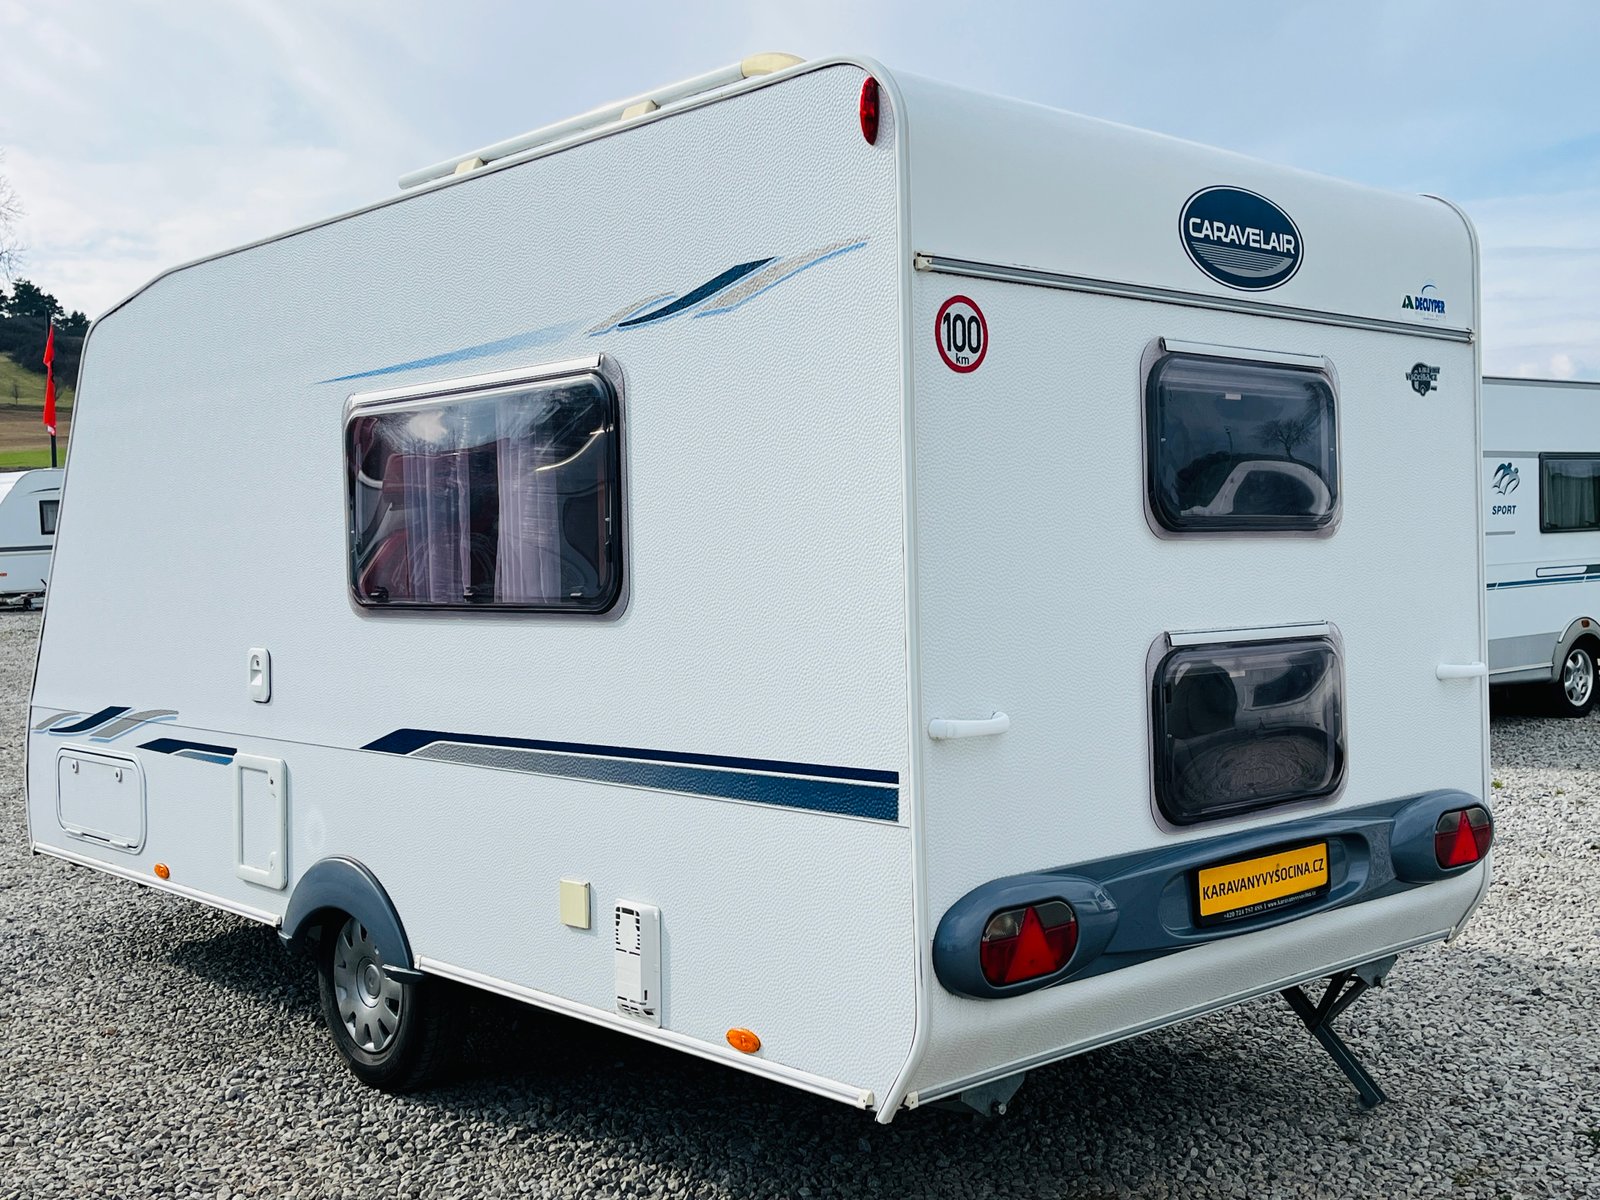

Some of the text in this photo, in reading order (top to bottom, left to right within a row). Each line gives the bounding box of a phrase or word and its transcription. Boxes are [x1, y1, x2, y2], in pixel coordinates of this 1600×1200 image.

[1189, 217, 1295, 254] CARAVELAIR
[1415, 296, 1445, 313] DECUYPER
[943, 312, 981, 354] 100
[956, 353, 969, 365] km
[1492, 505, 1516, 515] SPORT
